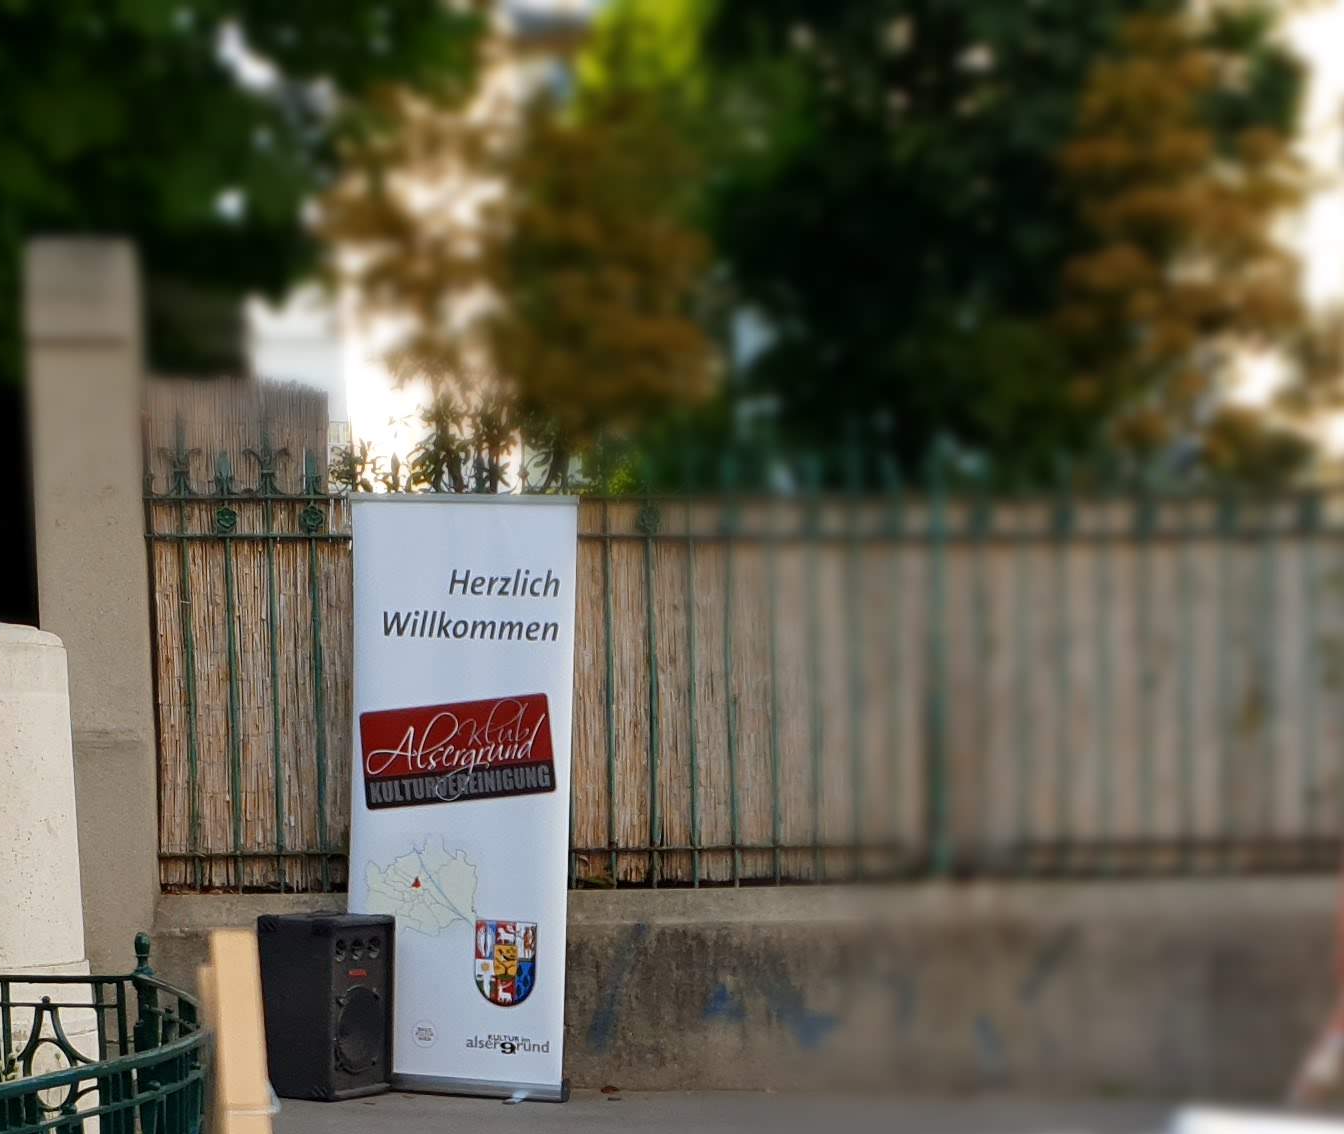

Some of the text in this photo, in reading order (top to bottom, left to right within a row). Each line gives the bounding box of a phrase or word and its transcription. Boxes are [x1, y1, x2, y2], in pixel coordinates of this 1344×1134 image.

[448, 568, 561, 598] Herzlich
[382, 609, 560, 642] Willkommen
[366, 711, 546, 802] Alsergrund
[368, 764, 552, 804] KULTURVEREINIGUNG
